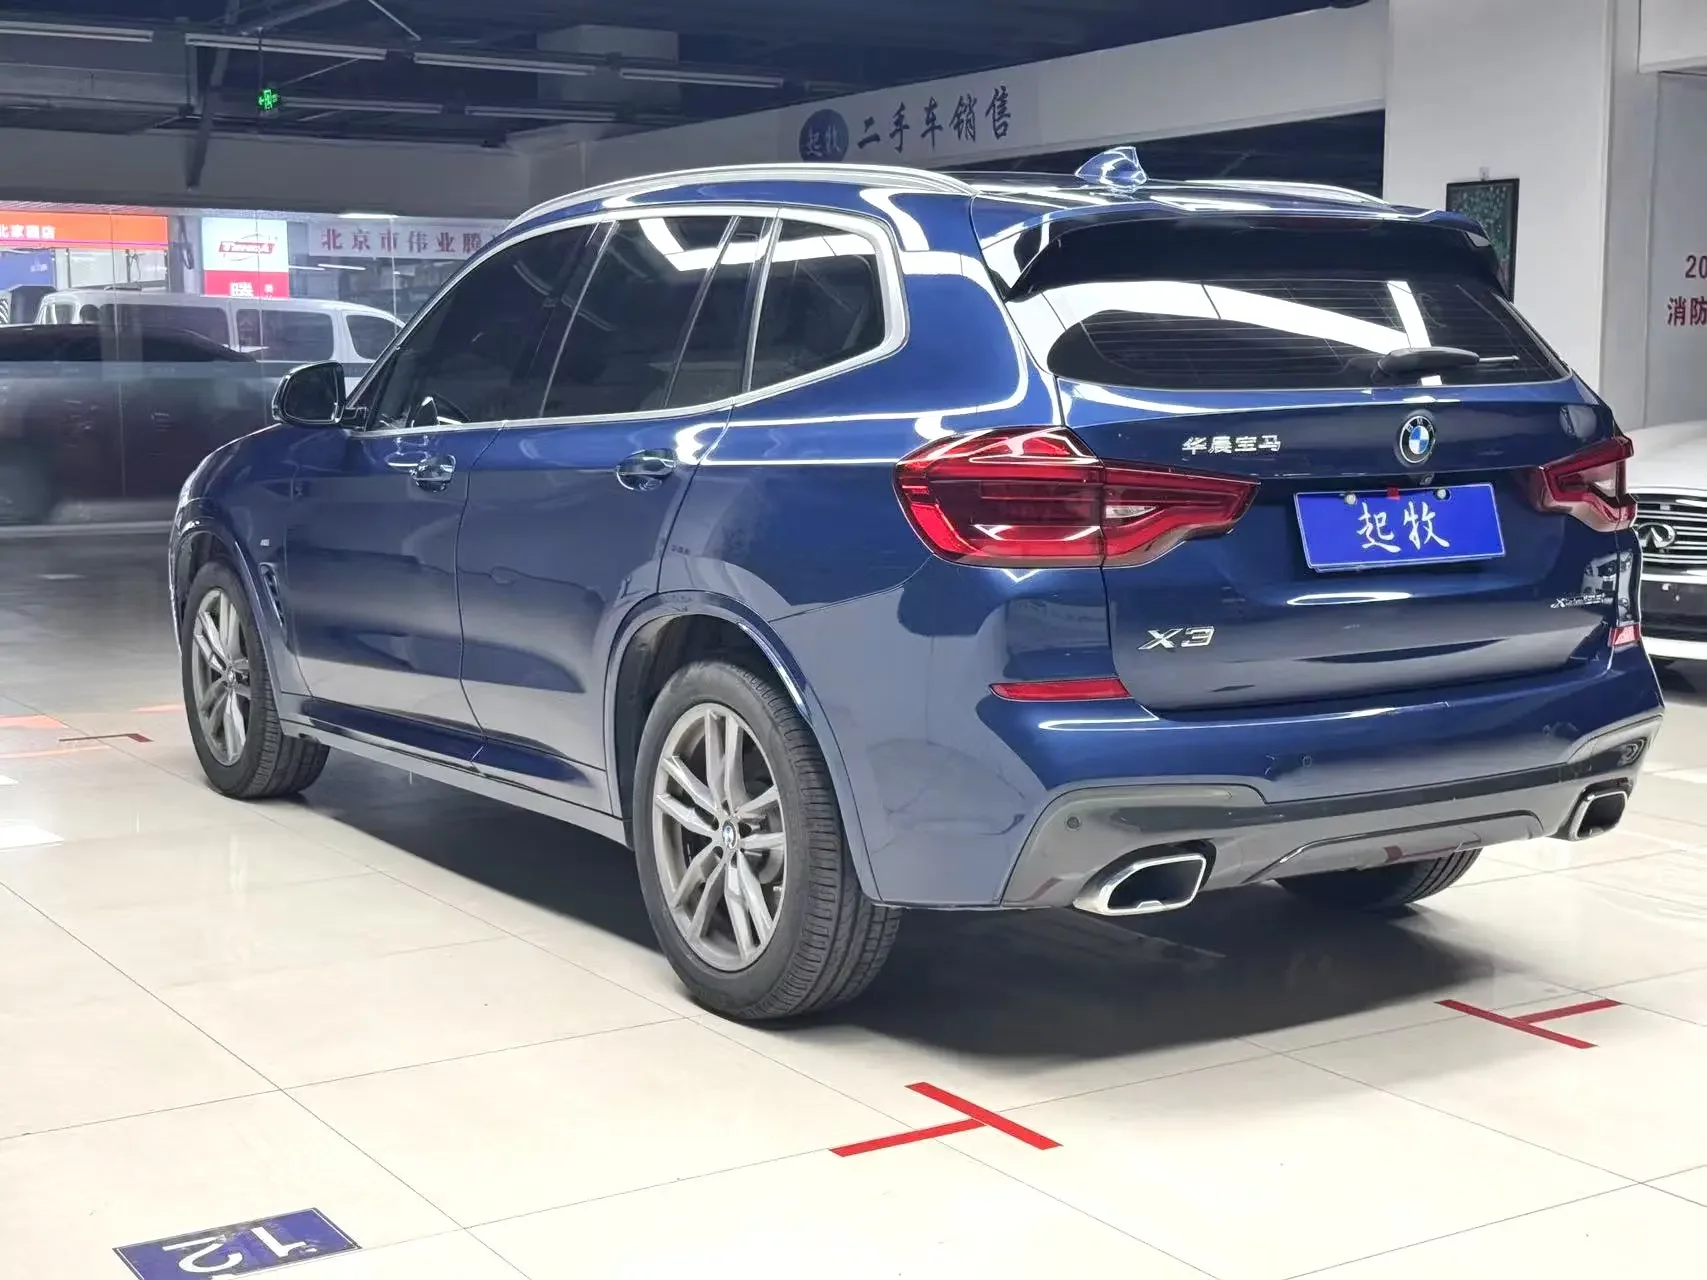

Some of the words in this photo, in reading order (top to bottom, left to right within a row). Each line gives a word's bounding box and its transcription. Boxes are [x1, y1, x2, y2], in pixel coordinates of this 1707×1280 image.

[857, 86, 1012, 154] 二手车销售
[321, 228, 497, 253] 北京市伟业腾
[1685, 254, 1707, 279] 20
[1667, 296, 1707, 326] 消防
[1181, 435, 1281, 455] 华晨宝马
[1356, 501, 1450, 553] 起牧
[1138, 626, 1215, 650] X3
[162, 1226, 307, 1273] 12
